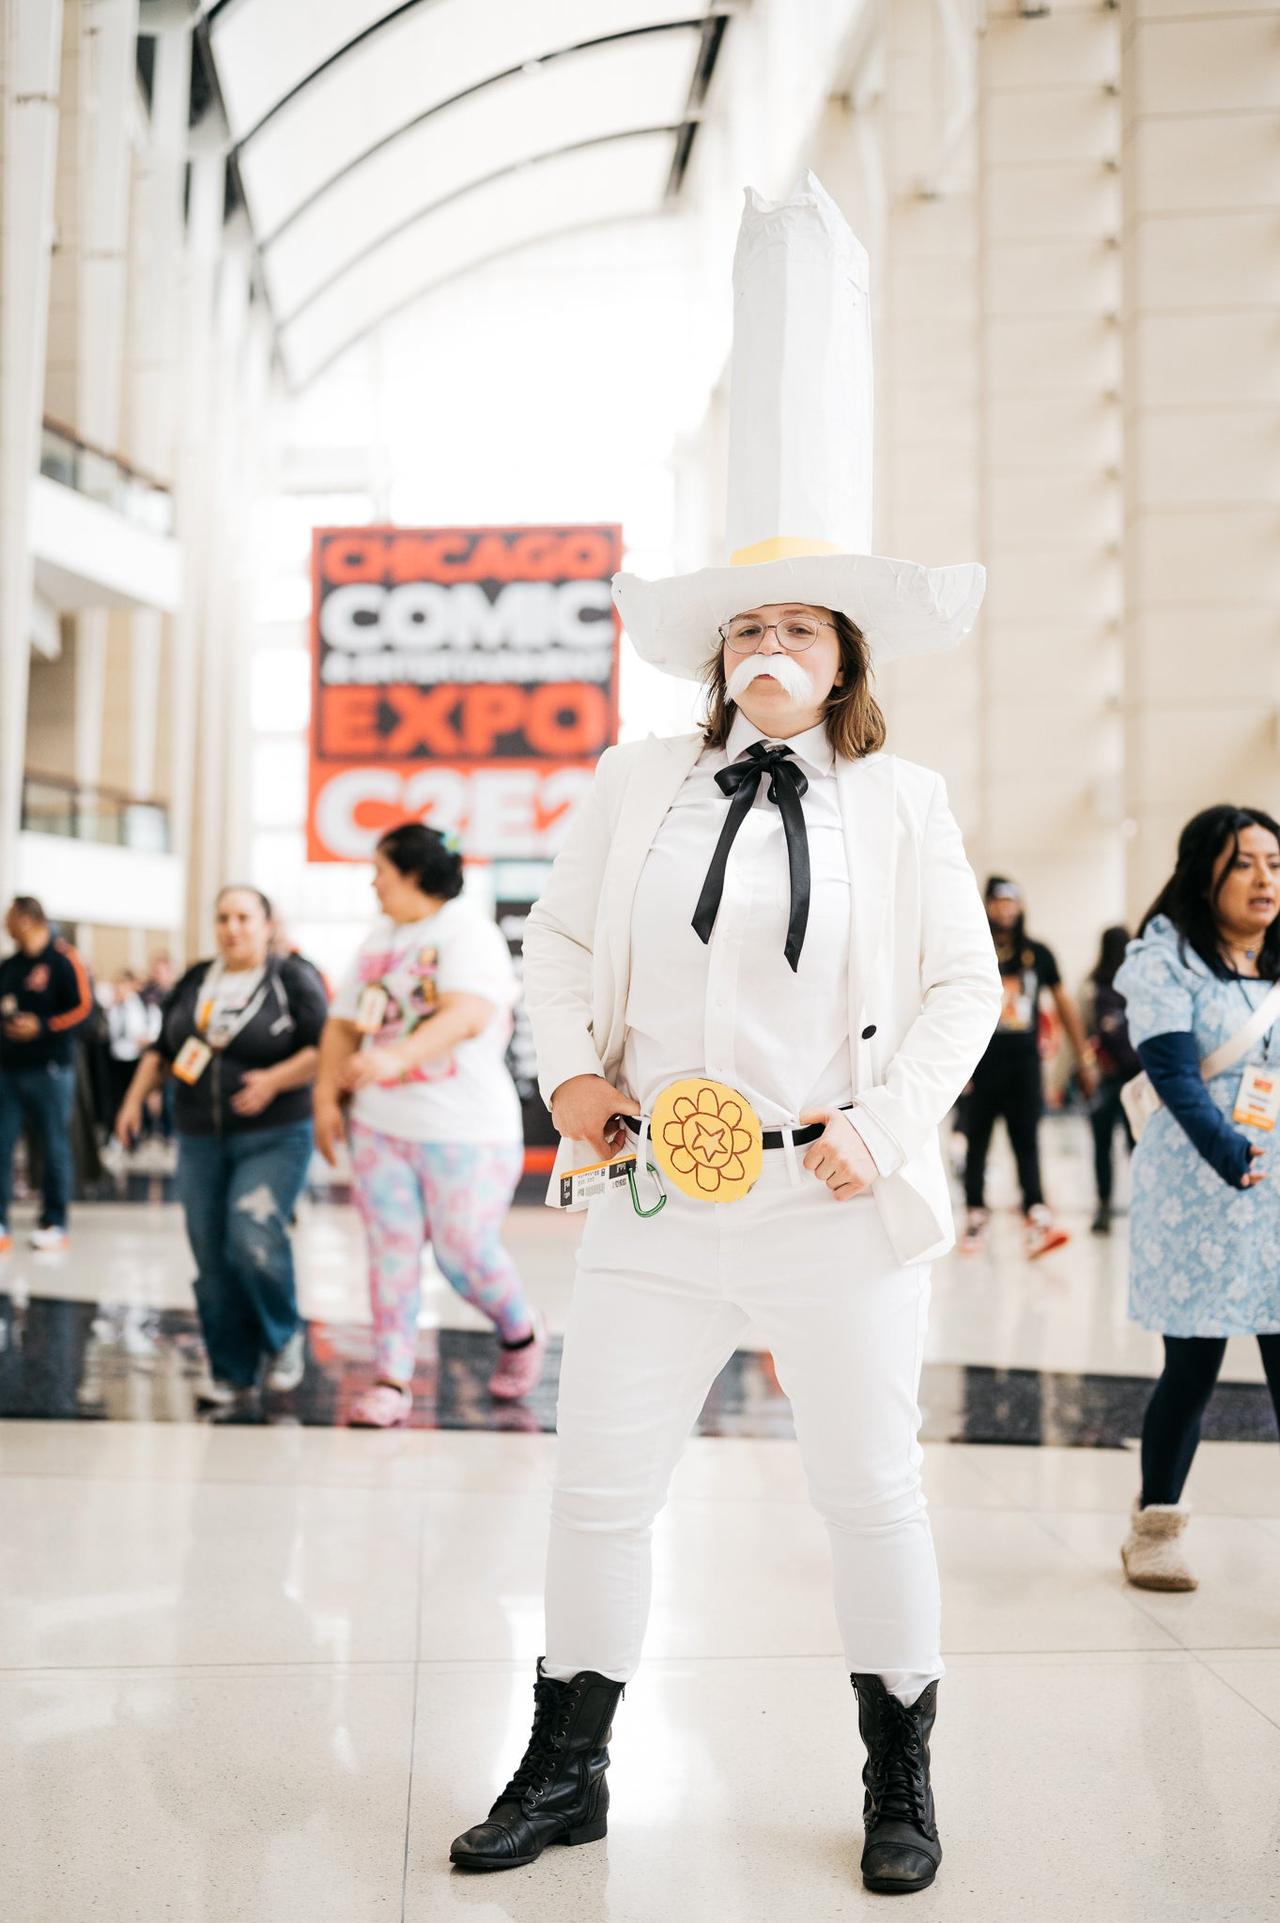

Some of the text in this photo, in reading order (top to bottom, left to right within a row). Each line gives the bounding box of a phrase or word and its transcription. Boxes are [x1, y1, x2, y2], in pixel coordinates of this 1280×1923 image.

[322, 535, 612, 584] CHICAGO
[320, 579, 613, 651] COMIC
[322, 680, 608, 755] EXPO
